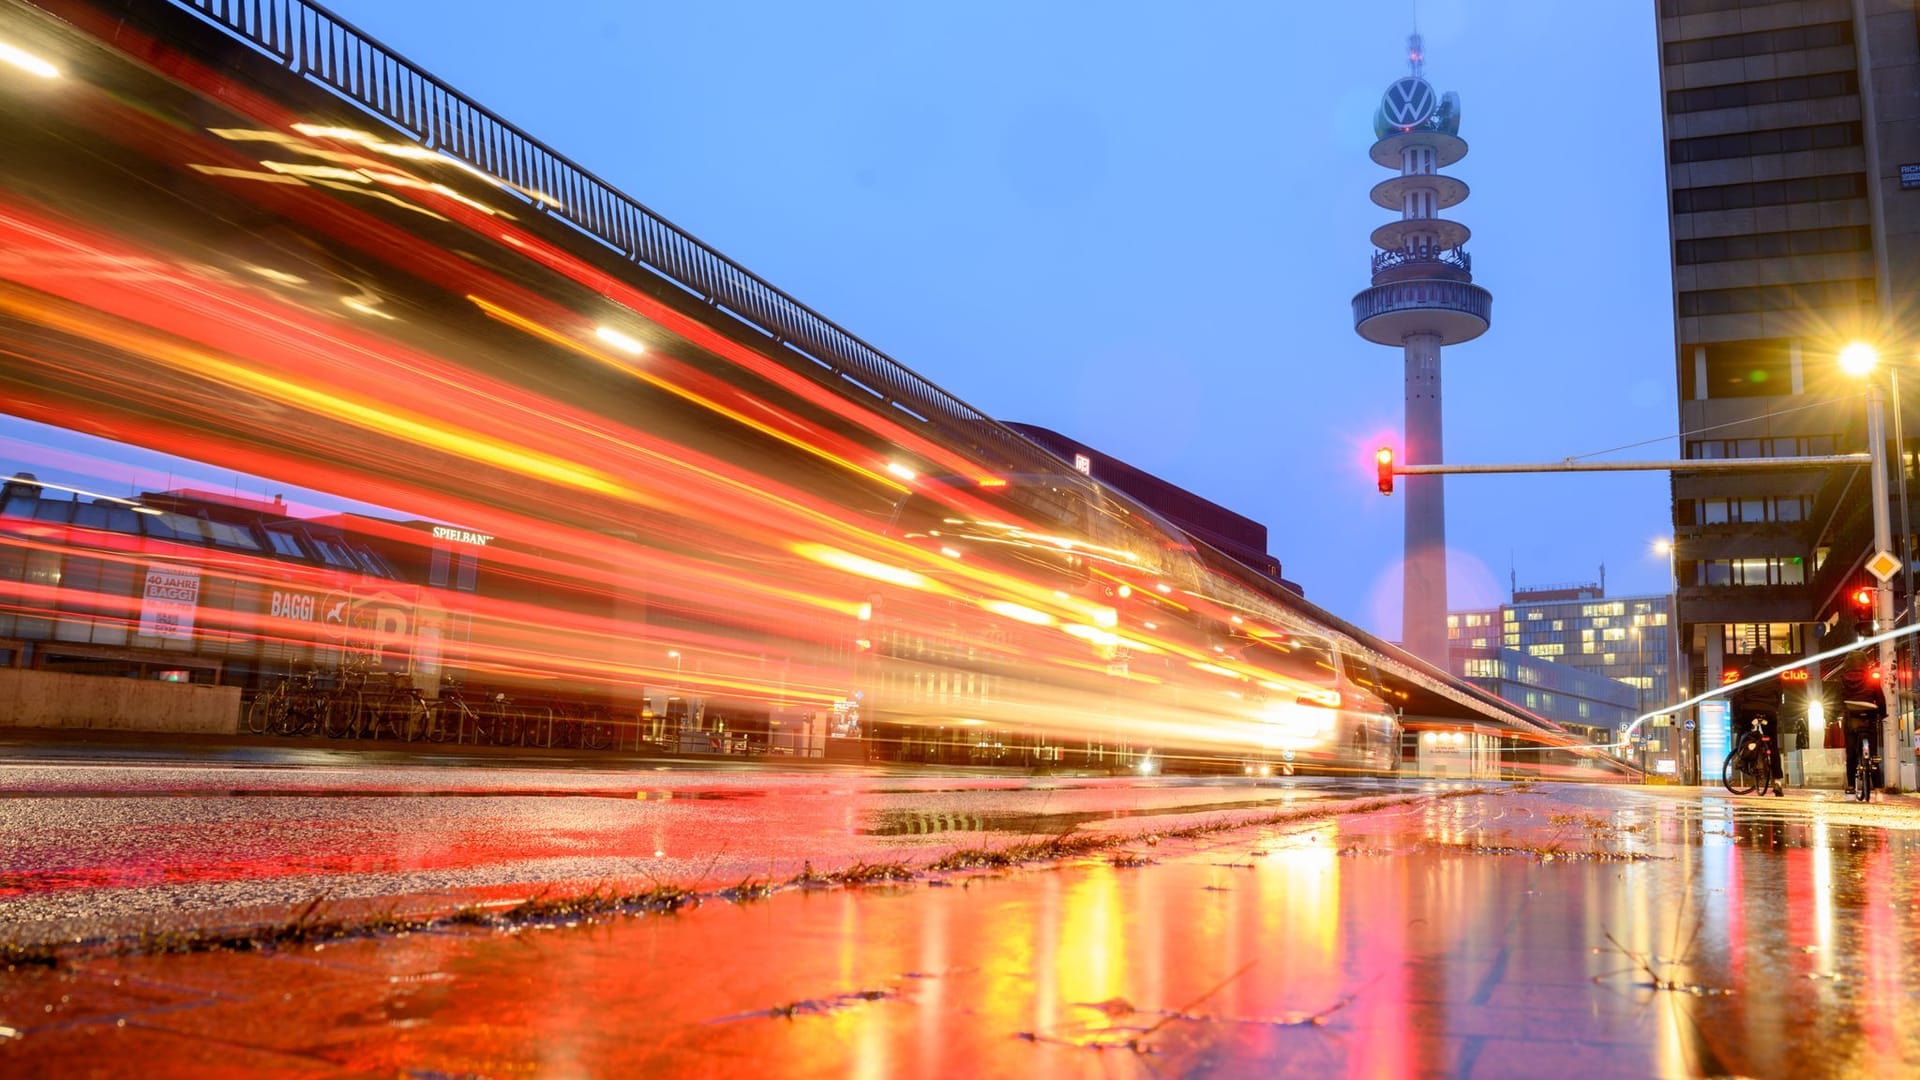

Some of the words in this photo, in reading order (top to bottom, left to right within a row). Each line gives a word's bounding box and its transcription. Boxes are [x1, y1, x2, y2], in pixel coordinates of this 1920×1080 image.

[1384, 79, 1431, 123] VW
[433, 526, 494, 545] SPIELBAN
[148, 575, 162, 585] 40
[164, 577, 198, 590] JAHRE
[149, 586, 193, 601] BAGGI
[271, 591, 315, 621] BAGGI
[1782, 670, 1809, 680] Club
